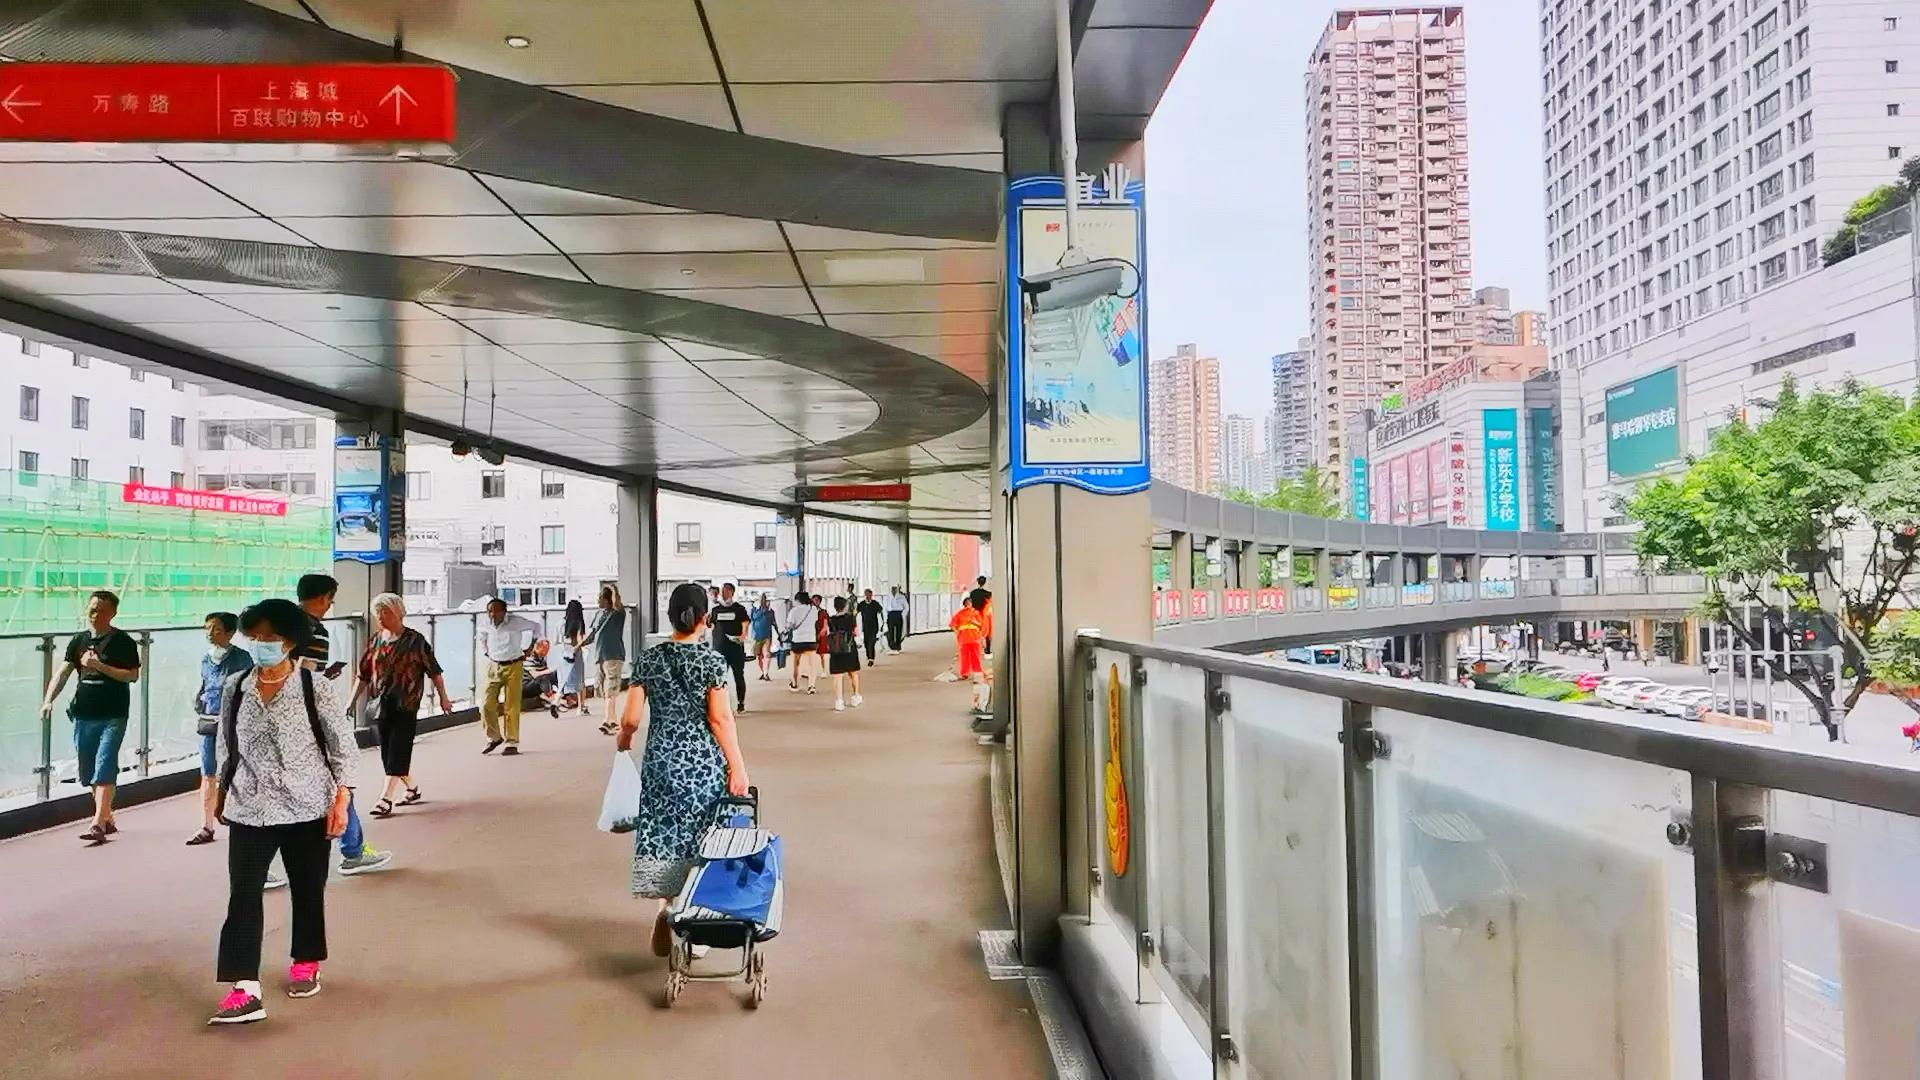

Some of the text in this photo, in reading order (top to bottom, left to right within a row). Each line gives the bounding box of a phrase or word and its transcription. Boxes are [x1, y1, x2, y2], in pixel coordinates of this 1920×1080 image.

[259, 80, 338, 101] 上海城
[92, 92, 170, 115] 万寿路
[229, 107, 369, 129] 百联购物中心
[1497, 447, 1516, 522] 新东方学校
